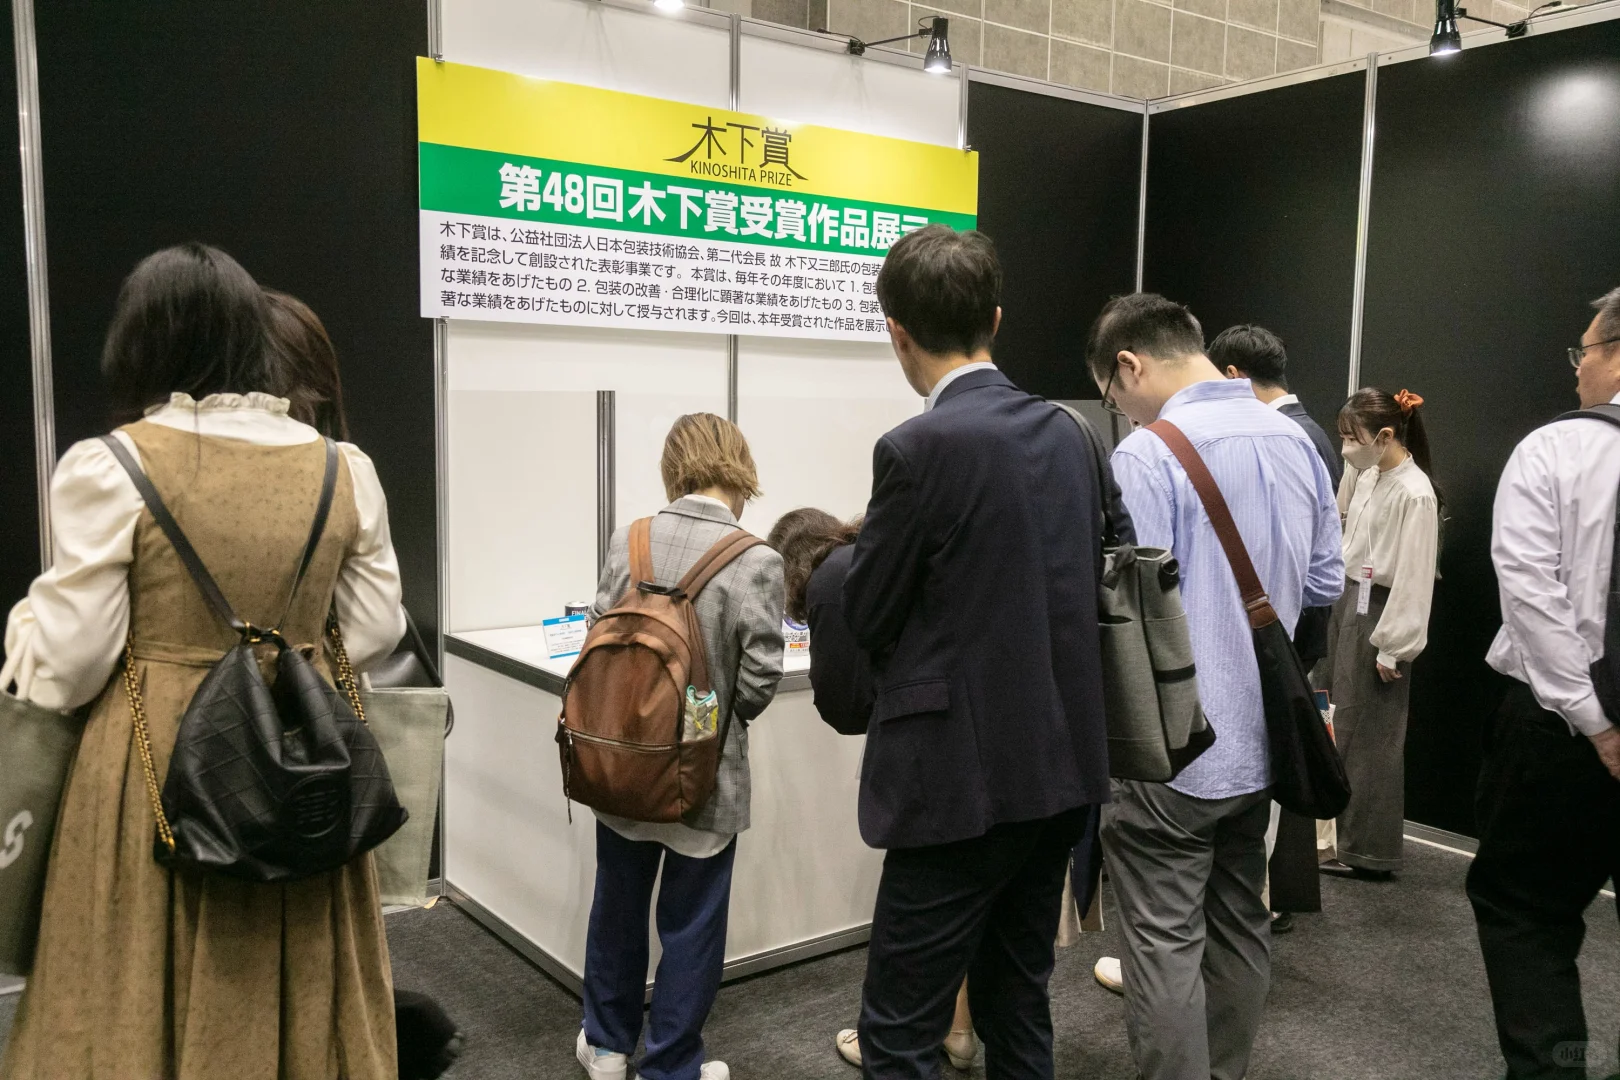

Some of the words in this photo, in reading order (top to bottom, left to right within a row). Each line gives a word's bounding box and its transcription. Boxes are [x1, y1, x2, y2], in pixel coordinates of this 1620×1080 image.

[663, 116, 809, 180] 木下賞
[690, 160, 757, 181] KINOSHITA
[760, 169, 792, 186] PRIZE
[441, 268, 572, 292] な業績をあげたもの
[577, 278, 590, 293] 2.
[859, 300, 884, 314] 包装
